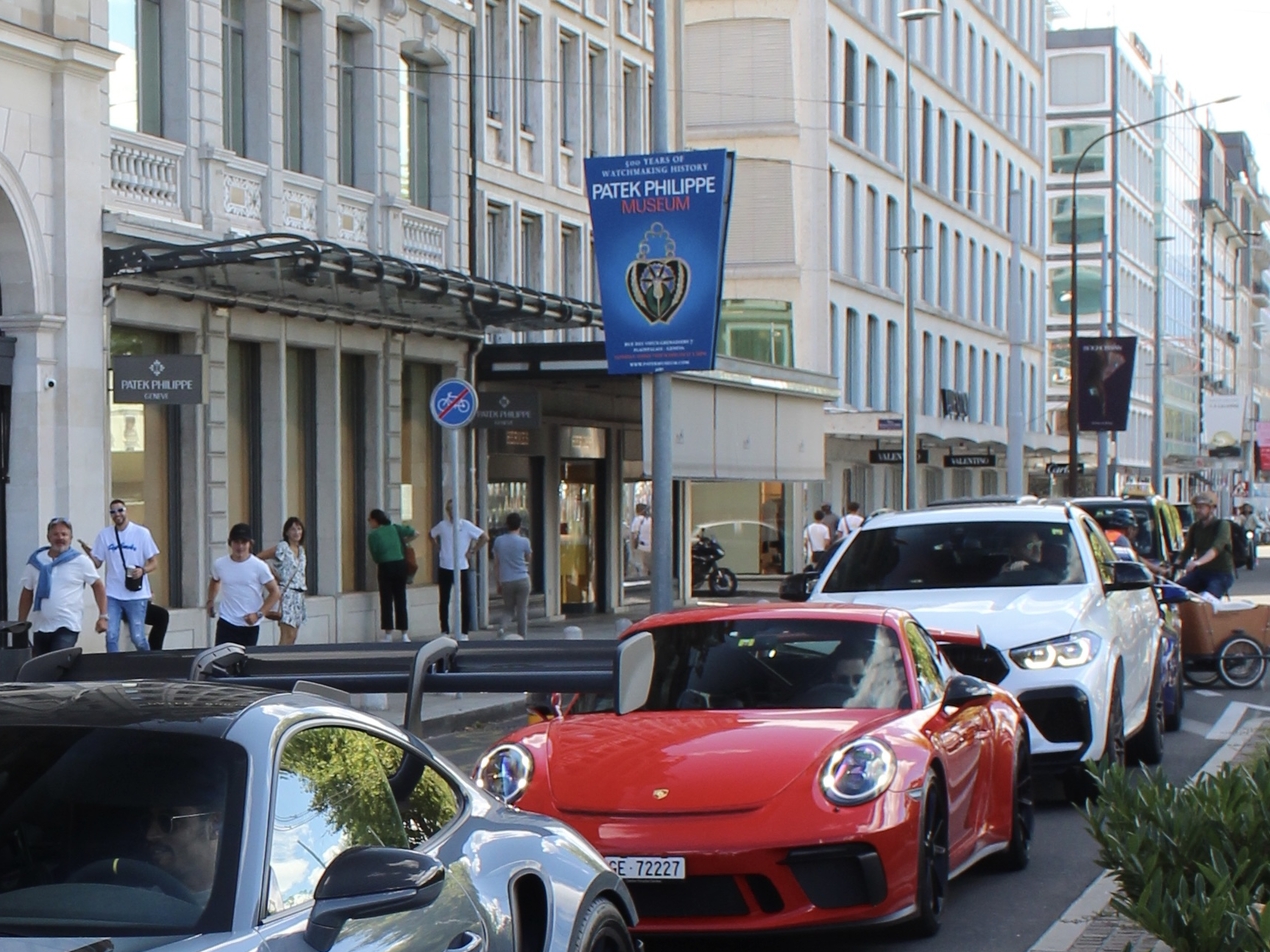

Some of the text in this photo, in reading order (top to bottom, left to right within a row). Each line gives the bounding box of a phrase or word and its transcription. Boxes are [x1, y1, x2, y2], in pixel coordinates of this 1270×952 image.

[643, 156, 670, 165] YEARS
[672, 155, 684, 163] OF
[602, 163, 708, 177] WATCHMAKING HISTORY
[592, 176, 716, 200] PATEK PHILIPPE
[621, 196, 690, 214] MUSEUM
[121, 380, 193, 390] PATEK PHILIPPE
